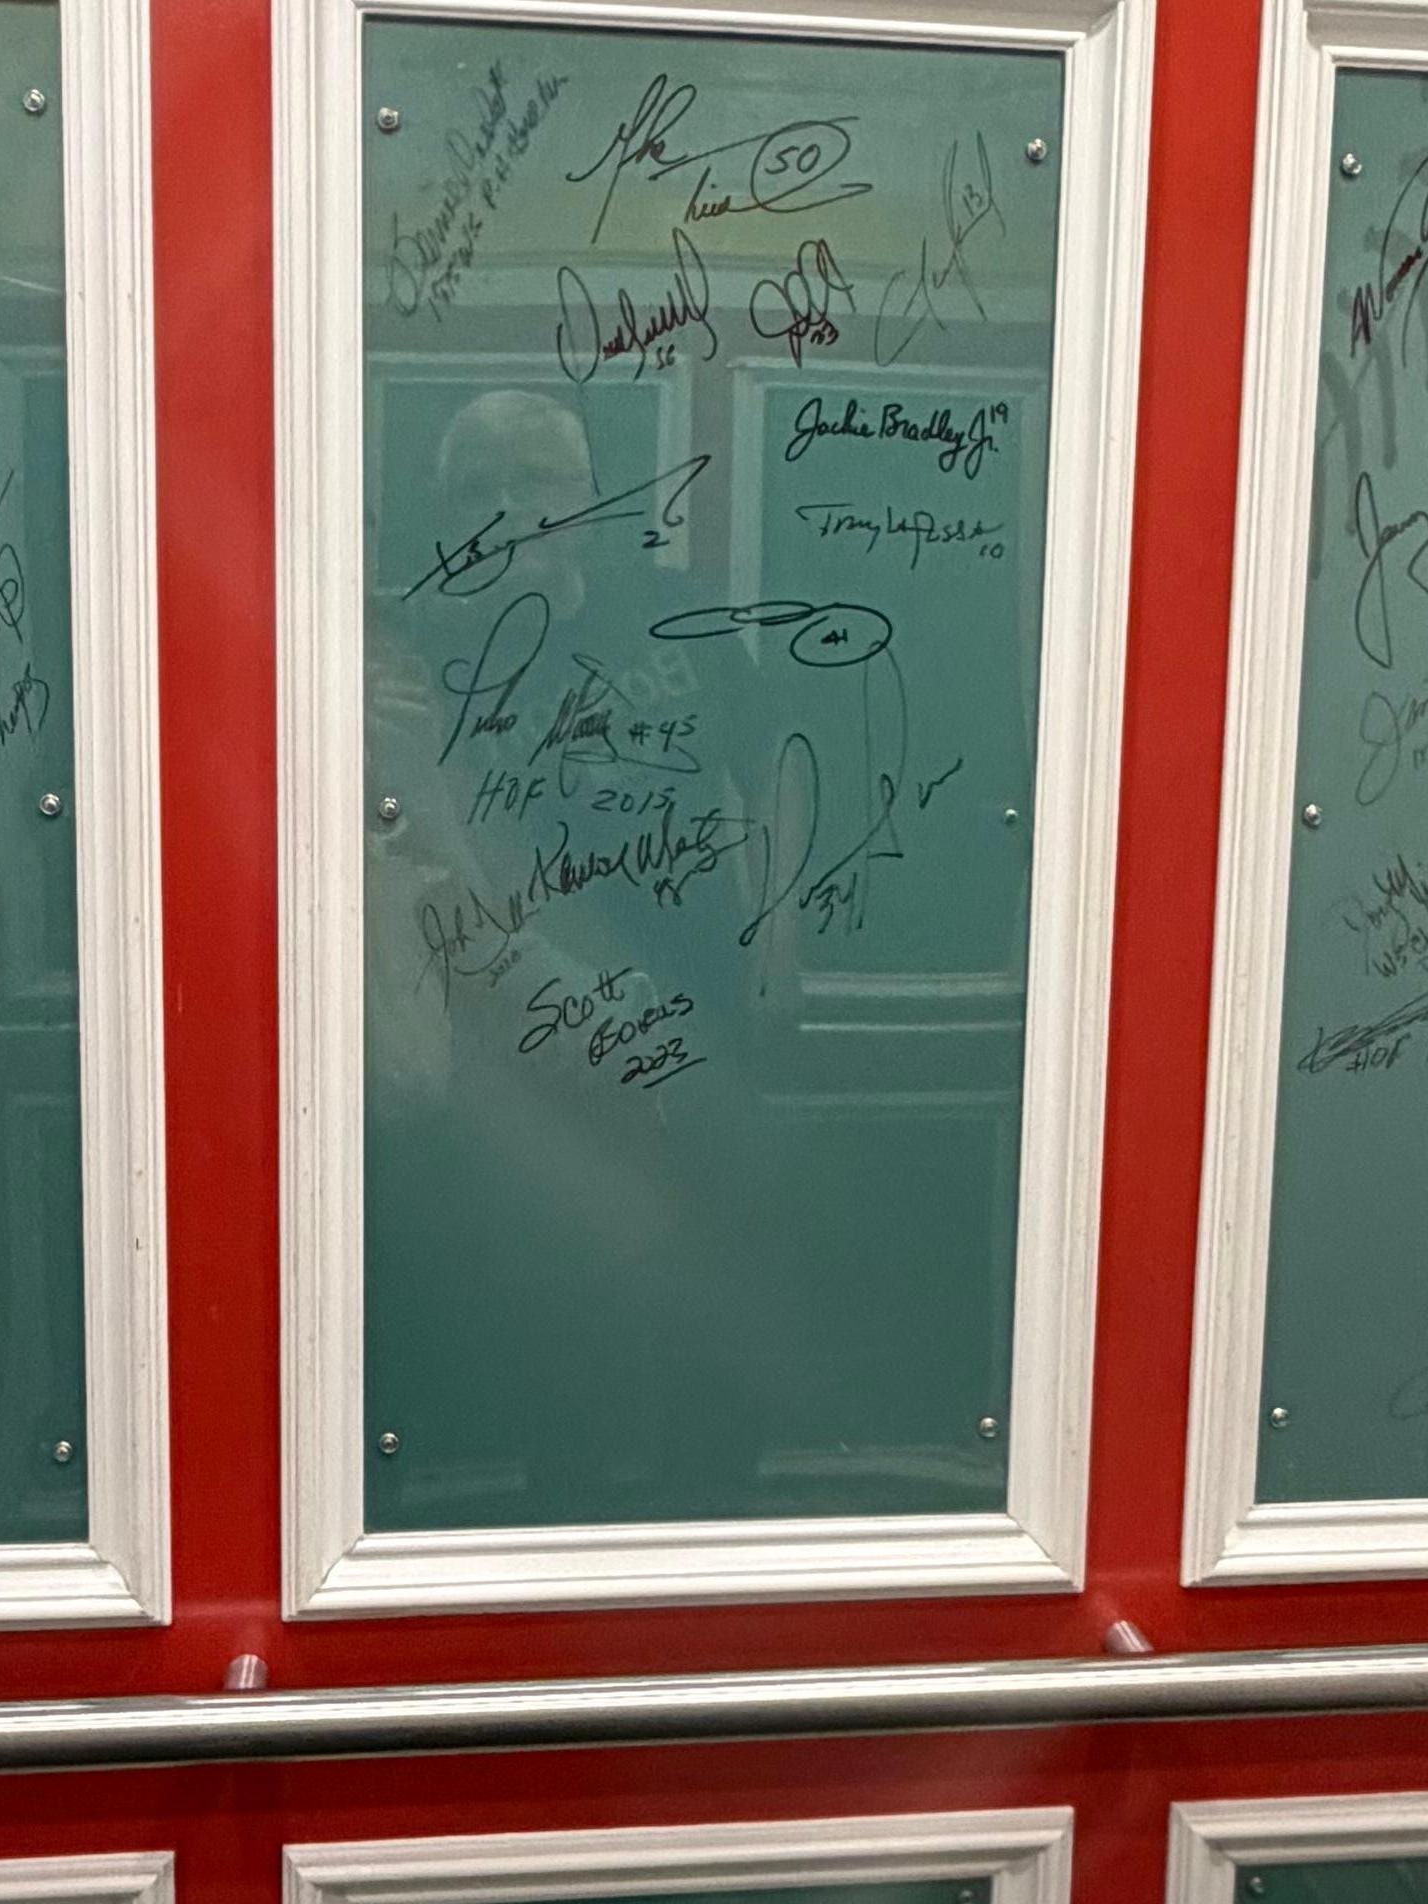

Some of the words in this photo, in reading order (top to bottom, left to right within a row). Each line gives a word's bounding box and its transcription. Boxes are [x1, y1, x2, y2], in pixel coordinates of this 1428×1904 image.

[765, 142, 823, 175] 50
[784, 396, 876, 463] Jackie
[878, 402, 969, 473] Bradley
[963, 407, 1000, 481] Jr.
[989, 400, 1010, 426] 19
[518, 966, 635, 1054] Scott
[620, 1036, 690, 1086] 2023
